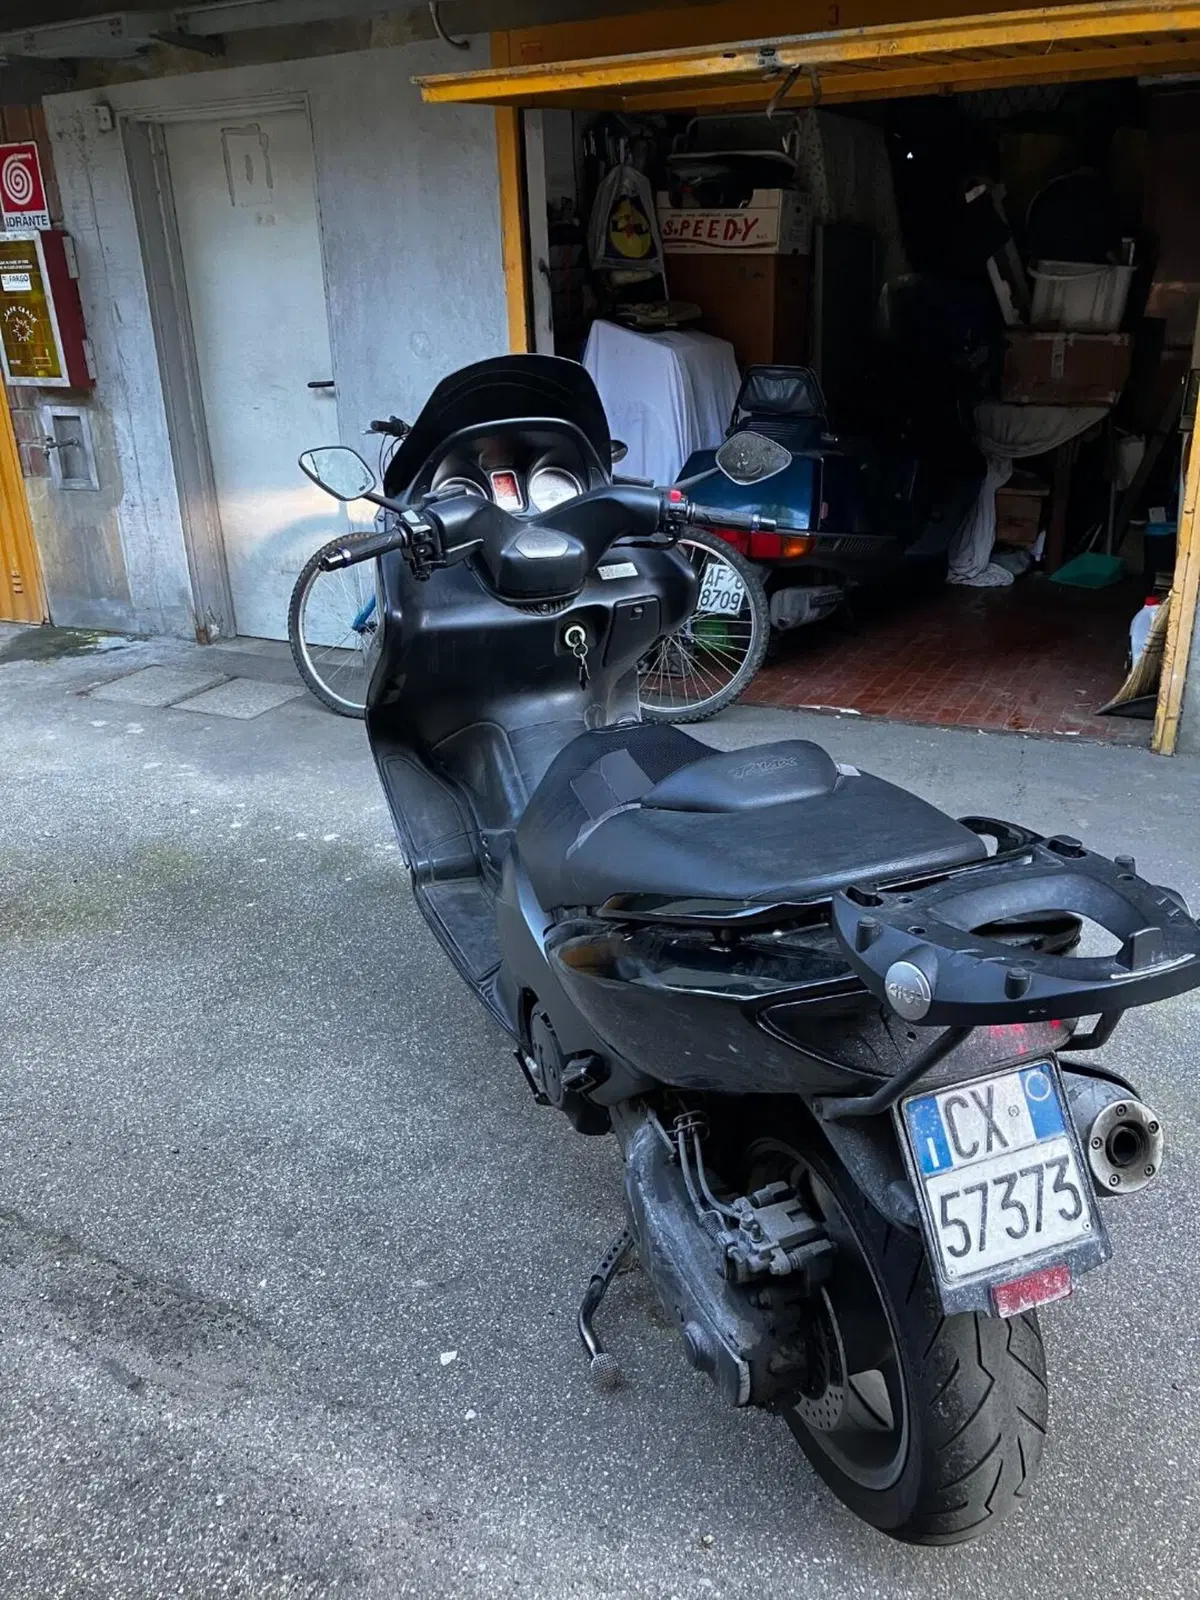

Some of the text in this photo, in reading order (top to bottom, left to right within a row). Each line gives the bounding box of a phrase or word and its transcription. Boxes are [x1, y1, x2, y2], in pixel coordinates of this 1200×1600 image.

[5, 214, 48, 228] IDRANTE
[700, 587, 741, 611] 8709
[943, 1083, 1010, 1159] CX
[939, 1154, 1083, 1258] 57373
